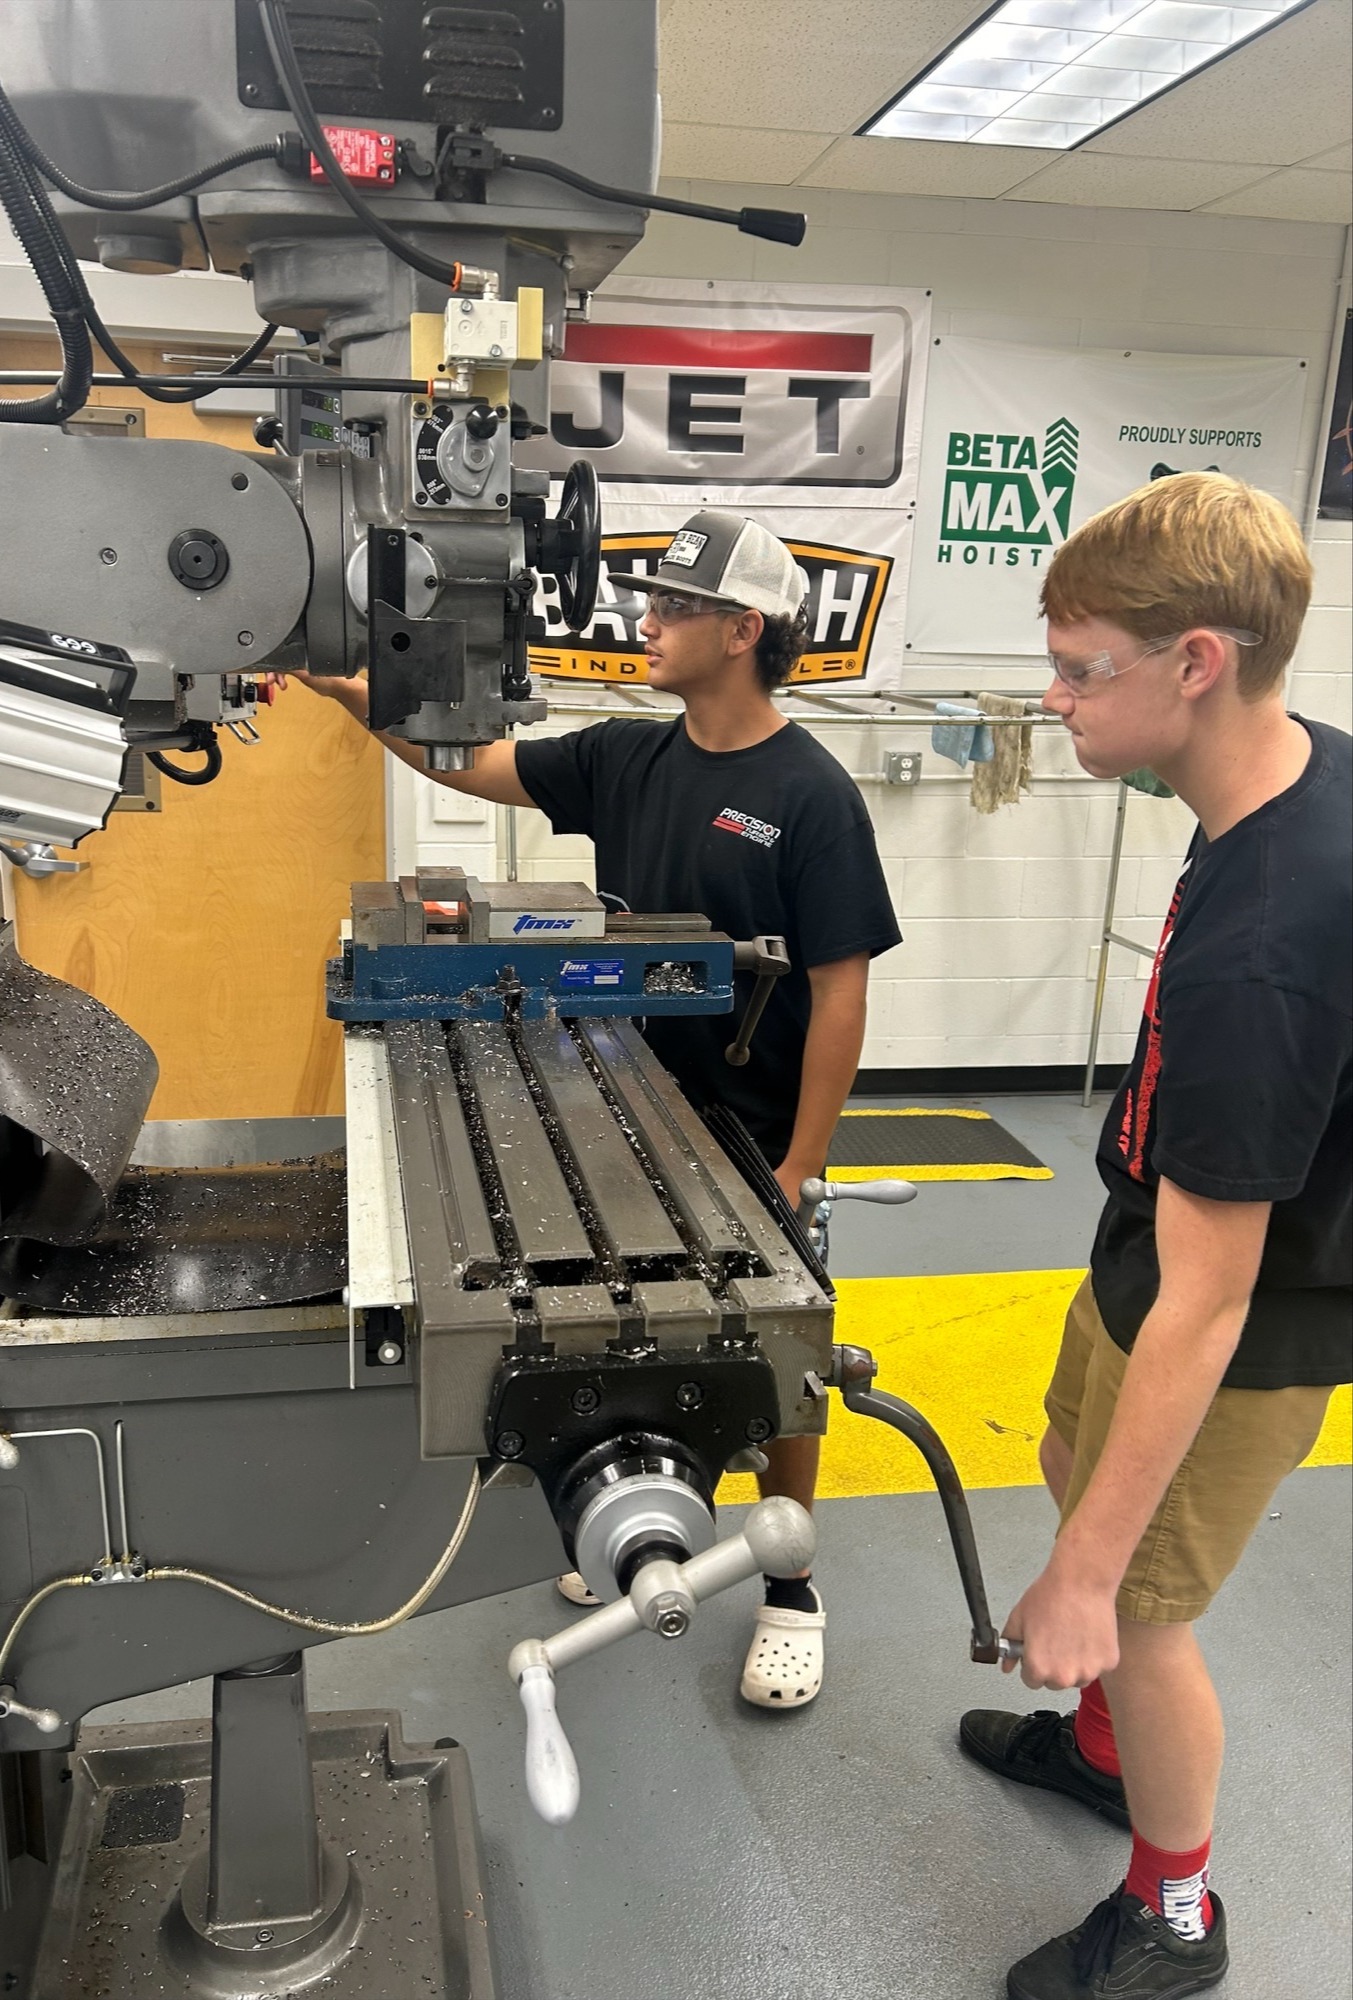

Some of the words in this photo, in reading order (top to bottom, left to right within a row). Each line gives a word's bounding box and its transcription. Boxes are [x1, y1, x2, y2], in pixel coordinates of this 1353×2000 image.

[550, 371, 871, 456] JET
[947, 432, 1038, 470] BETA
[1119, 425, 1187, 444] PROUDLY
[1189, 428, 1262, 448] SUPPORTS
[946, 473, 1065, 545] MAX
[937, 544, 1057, 567] HOIST
[719, 807, 781, 839] PRECISION
